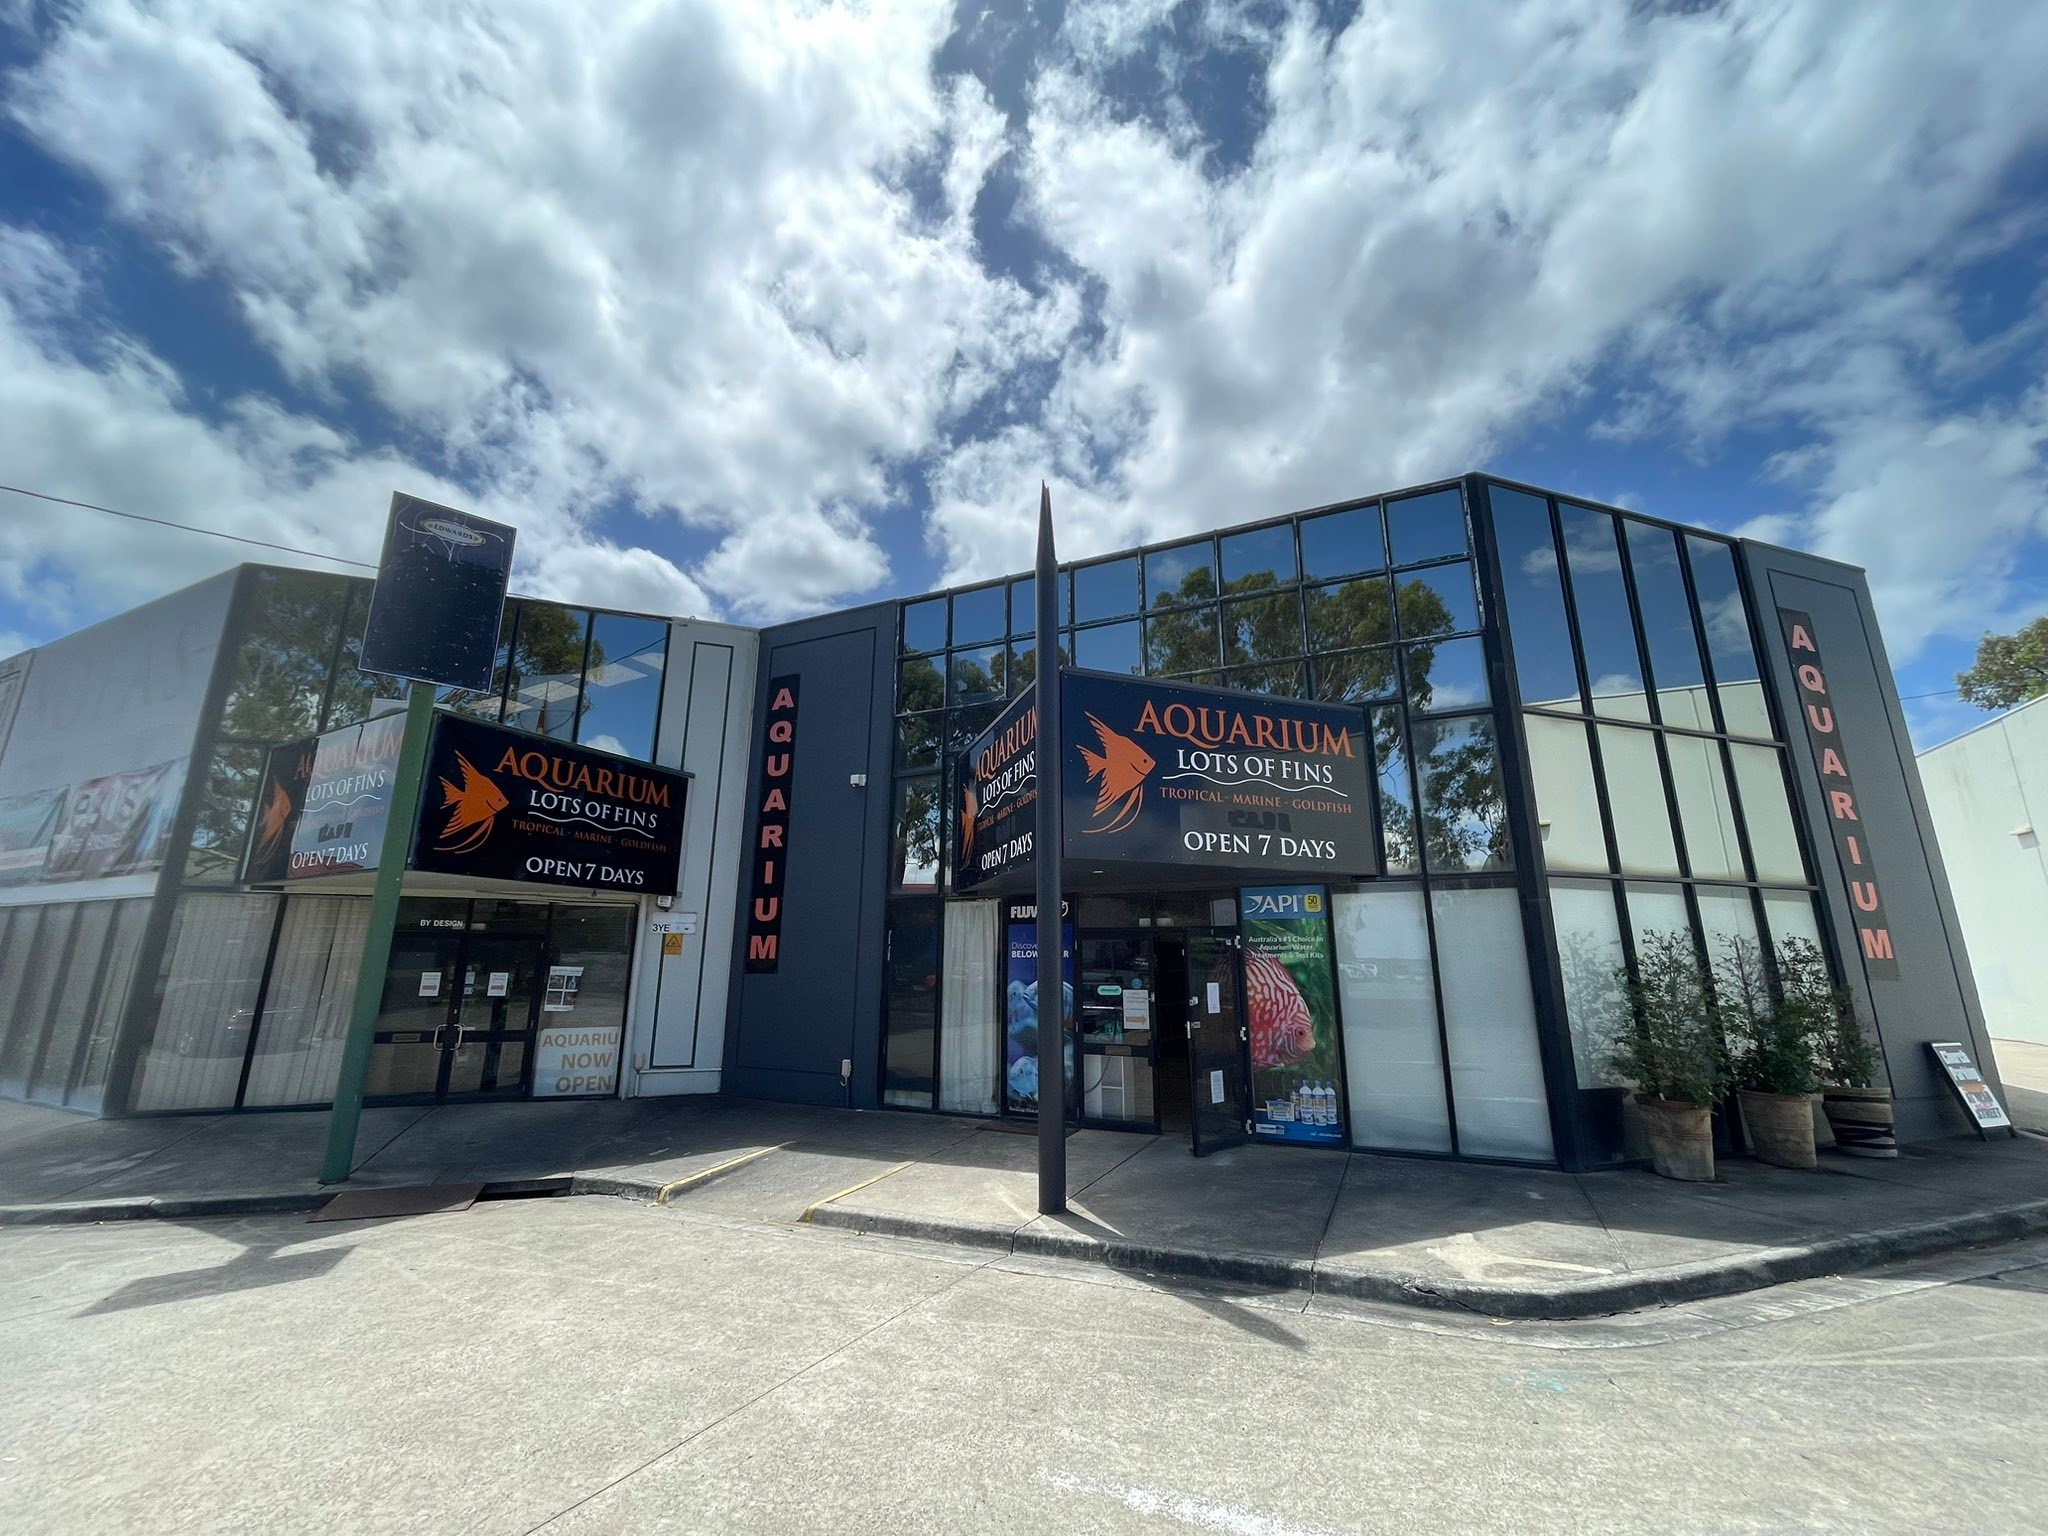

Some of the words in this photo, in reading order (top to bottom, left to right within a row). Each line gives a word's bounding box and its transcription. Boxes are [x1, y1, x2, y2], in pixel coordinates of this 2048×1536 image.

[434, 523, 473, 540] EDWARDS
[1133, 699, 1354, 758] AQUARIUM
[493, 746, 671, 809] AQUARIUM
[982, 776, 1000, 804] LOTS
[1002, 766, 1013, 791] OF
[1014, 750, 1035, 783] FINS
[1177, 749, 1238, 775] LOTS
[1244, 755, 1277, 778] OF
[1281, 760, 1333, 784] FINS
[306, 781, 334, 803] LOTS
[336, 777, 353, 796] OF
[354, 770, 386, 793] FINS
[1016, 788, 1037, 809] GOLDFIS
[1159, 786, 1224, 803] TROPICAL
[1232, 793, 1281, 808] MARINE
[1292, 799, 1352, 814] GOLDFISH
[1792, 624, 1894, 959] AQUARIUM
[529, 789, 581, 814] LOTS
[585, 801, 612, 819] OF
[614, 807, 658, 829] FINS
[750, 687, 794, 959] AQUARIUM
[512, 819, 566, 837] TROPICAL
[573, 830, 613, 844] MARINE
[620, 838, 667, 853] GOLDFISH
[1183, 831, 1250, 855] OPEN
[1257, 835, 1271, 856] 7
[1280, 837, 1337, 860] DAYS
[291, 849, 325, 869] OPEN
[325, 847, 335, 866] 7
[336, 842, 369, 864] DAYS
[981, 847, 1002, 871] OPEN
[1002, 843, 1008, 864] 7
[1010, 831, 1033, 858] DAYS
[526, 856, 582, 880] OPEN
[585, 864, 597, 880] 7
[600, 867, 644, 885] DAYS
[1010, 905, 1037, 919] FLUV
[1260, 894, 1299, 913] API
[1308, 895, 1318, 905] 50
[420, 919, 432, 927] BY
[433, 919, 464, 928] DESIGN
[1011, 941, 1038, 950] Discov
[542, 1032, 619, 1048] AQUARIU
[561, 1052, 613, 1070] NOW
[555, 1075, 613, 1093] OPEN
